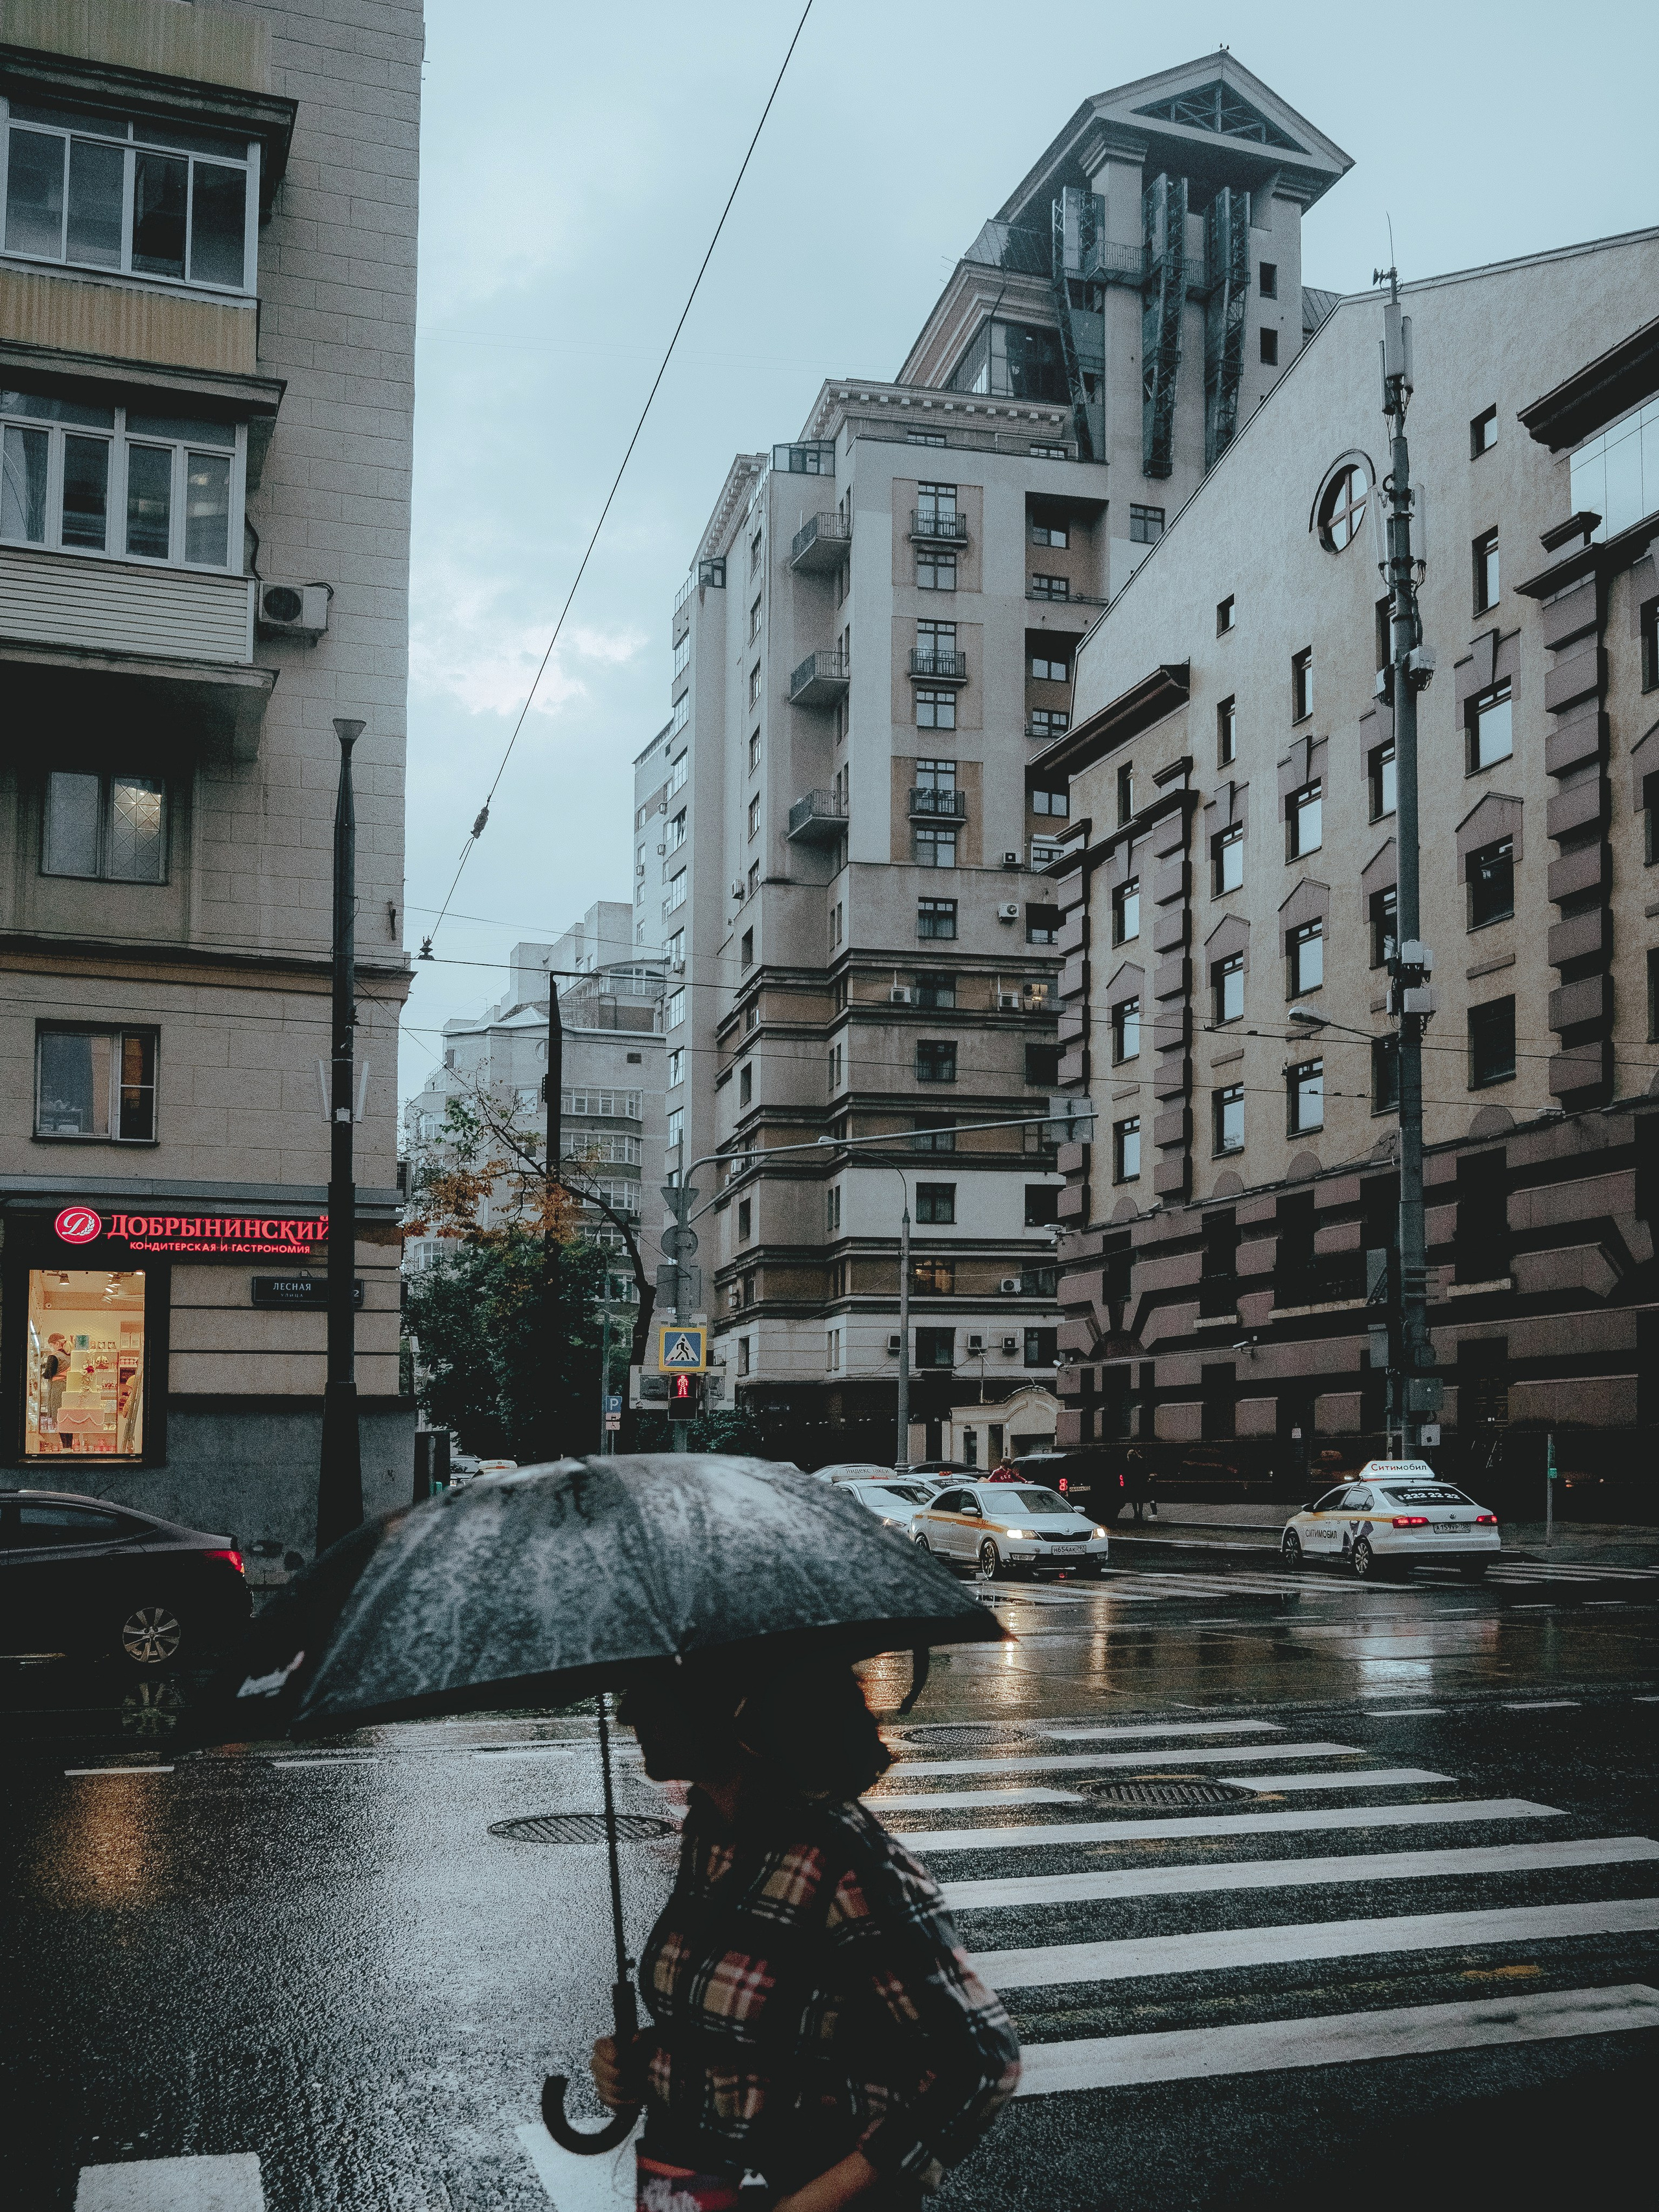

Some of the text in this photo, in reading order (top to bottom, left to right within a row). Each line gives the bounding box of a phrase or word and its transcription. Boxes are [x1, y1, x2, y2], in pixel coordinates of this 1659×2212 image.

[130, 1240, 311, 1254] КОНДИТЕРСКАЯ И ГАСТРОНОМИЯ
[272, 1282, 312, 1291] ЛЕСНАЯ
[610, 1397, 619, 1411] P
[1371, 1463, 1428, 1472] Ситимобил
[1305, 1529, 1338, 1539] СИТИМОБИЛ
